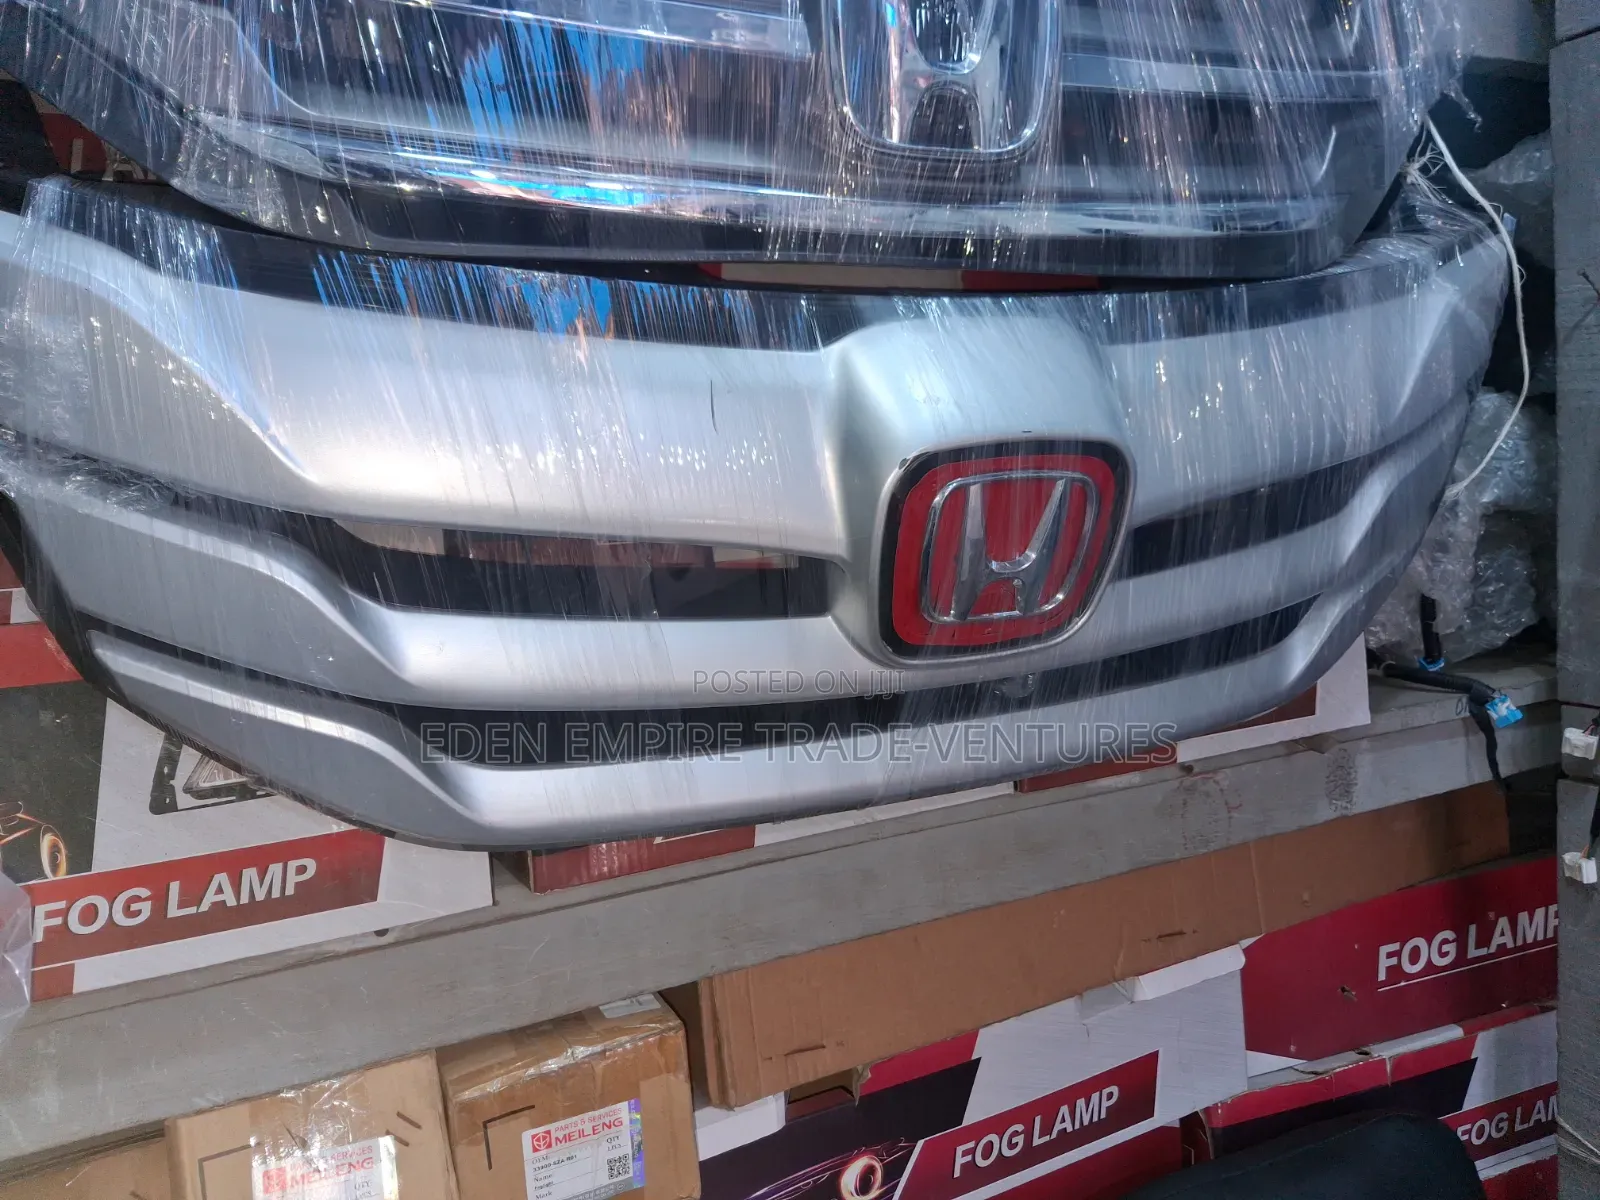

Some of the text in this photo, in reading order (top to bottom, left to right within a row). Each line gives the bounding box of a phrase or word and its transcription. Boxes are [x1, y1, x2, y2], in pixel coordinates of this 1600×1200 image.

[33, 857, 317, 943] FOG LAMP
[1377, 930, 1457, 981] FOG
[554, 1121, 579, 1134] PARTS
[588, 1107, 623, 1123] SERVICES
[554, 1116, 624, 1147] MEILENG
[953, 1085, 1119, 1178] FOG LAMP
